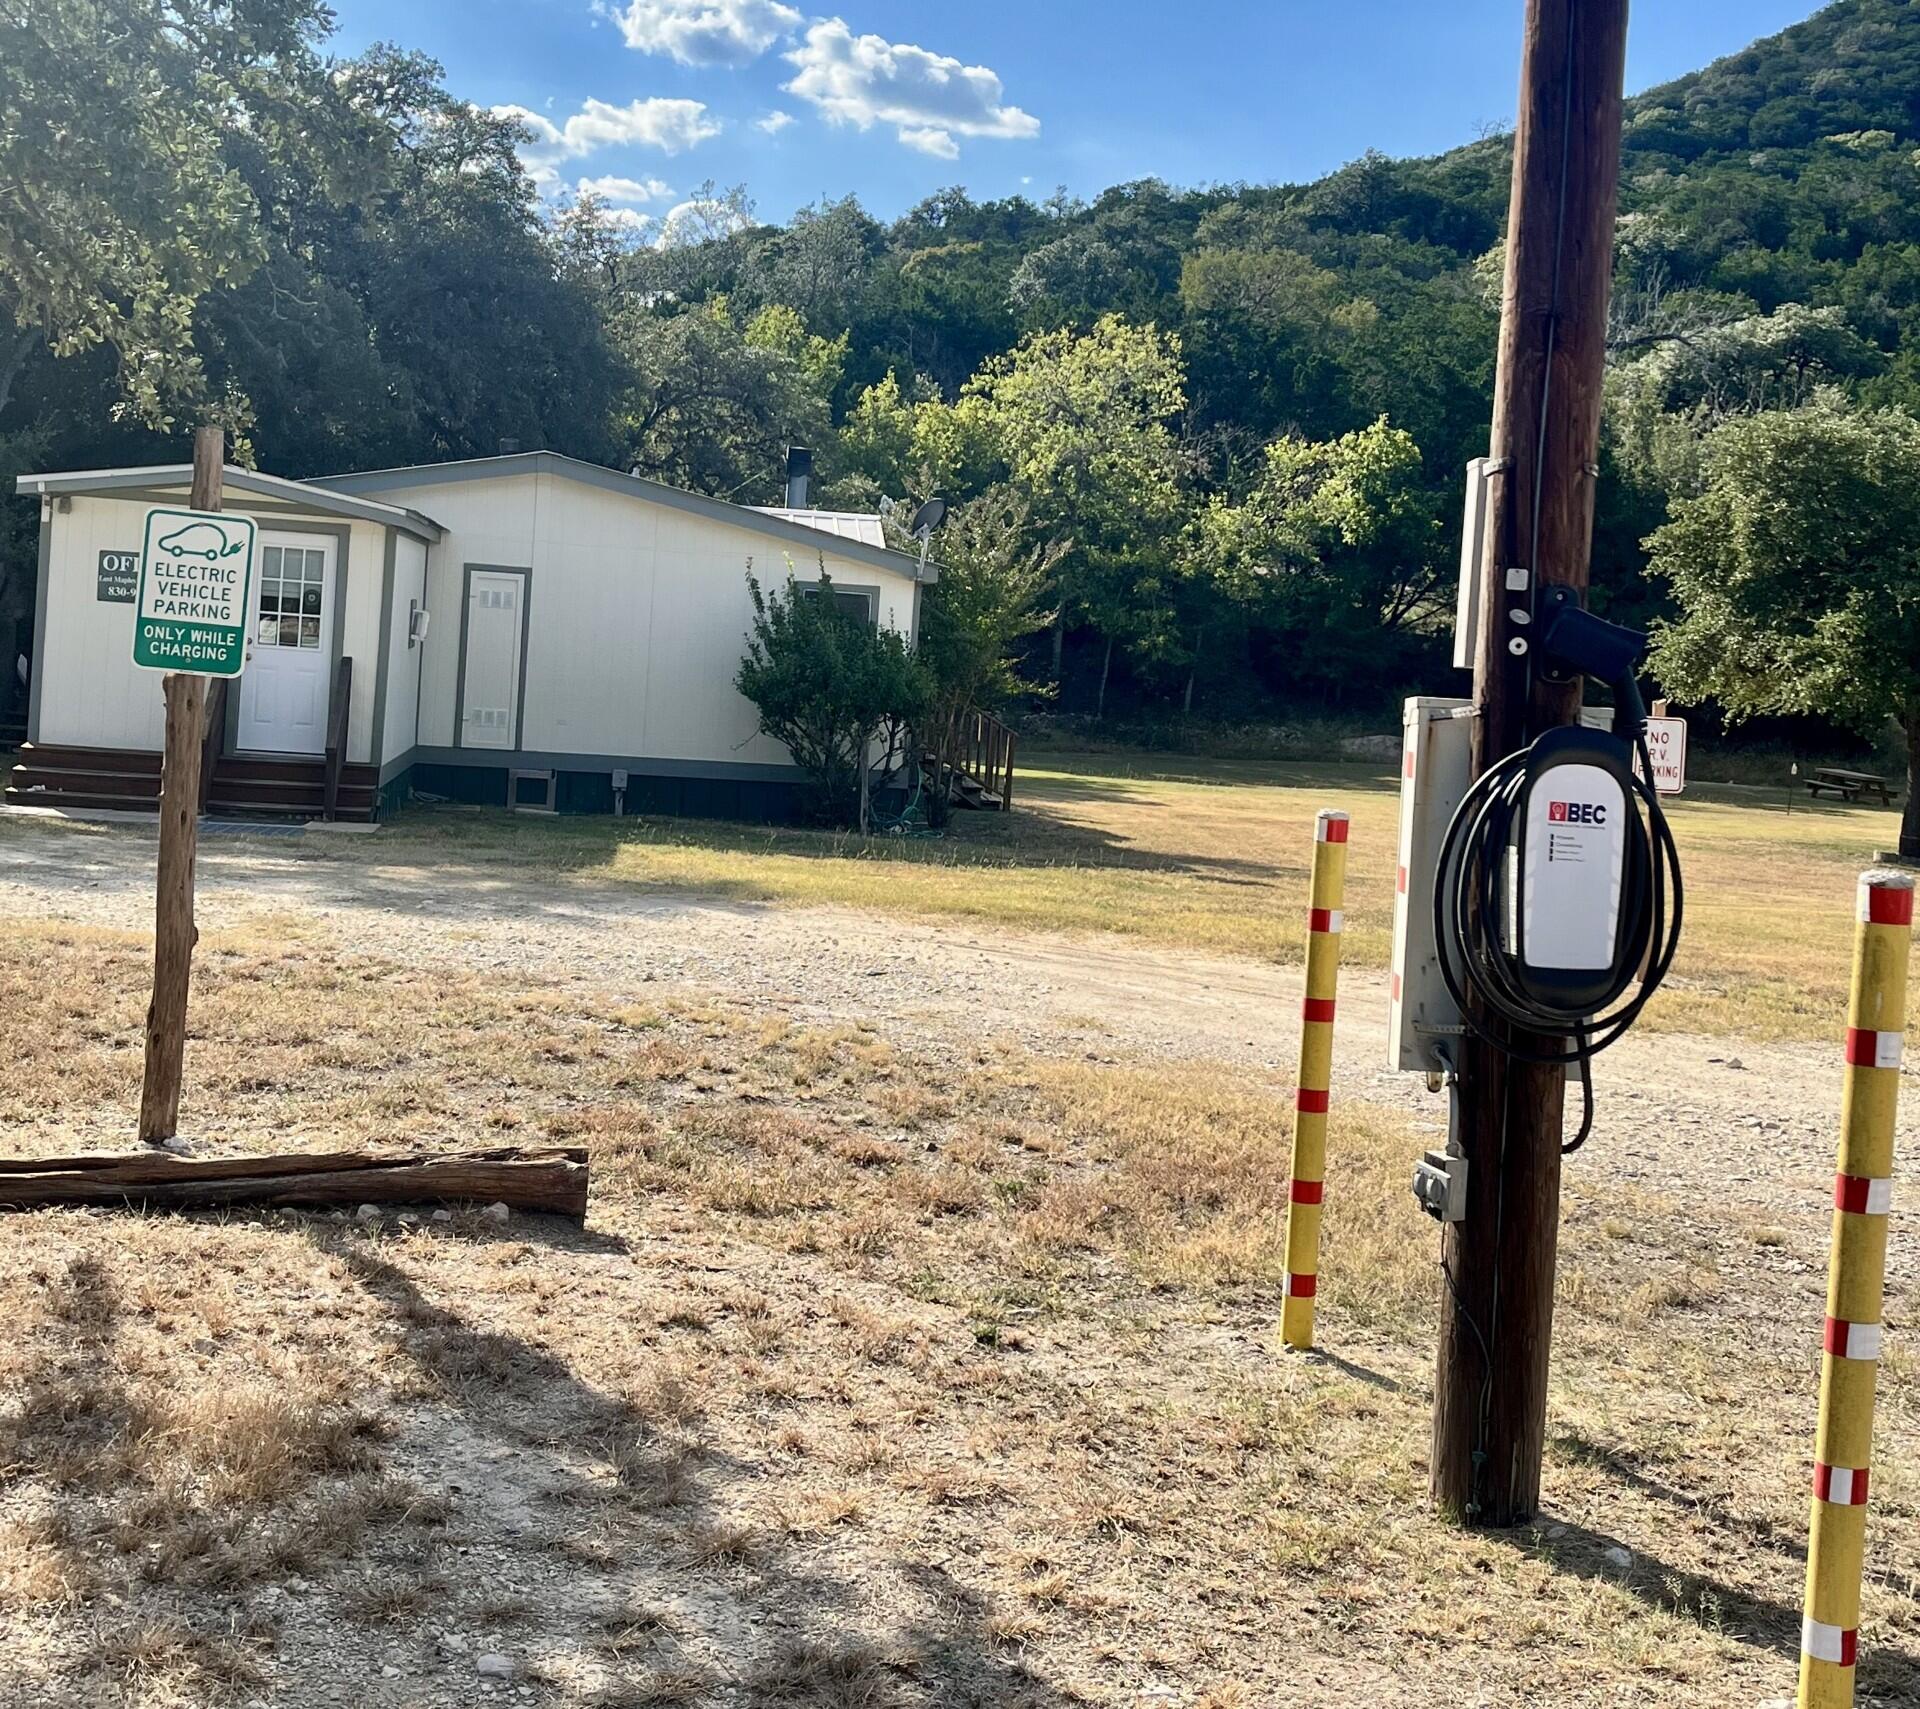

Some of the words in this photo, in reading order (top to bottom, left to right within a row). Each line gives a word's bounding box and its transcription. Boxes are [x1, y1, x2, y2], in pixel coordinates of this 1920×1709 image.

[154, 562, 237, 584] ELECTRIC
[157, 580, 232, 602] VEHICLE
[153, 599, 231, 620] PARKING
[143, 625, 186, 641] ONLY
[190, 629, 236, 646] WHILE
[149, 641, 227, 661] CHARGING
[1650, 732, 1670, 744] NO
[1638, 765, 1678, 778] PRKING
[1567, 802, 1607, 824] BEC
